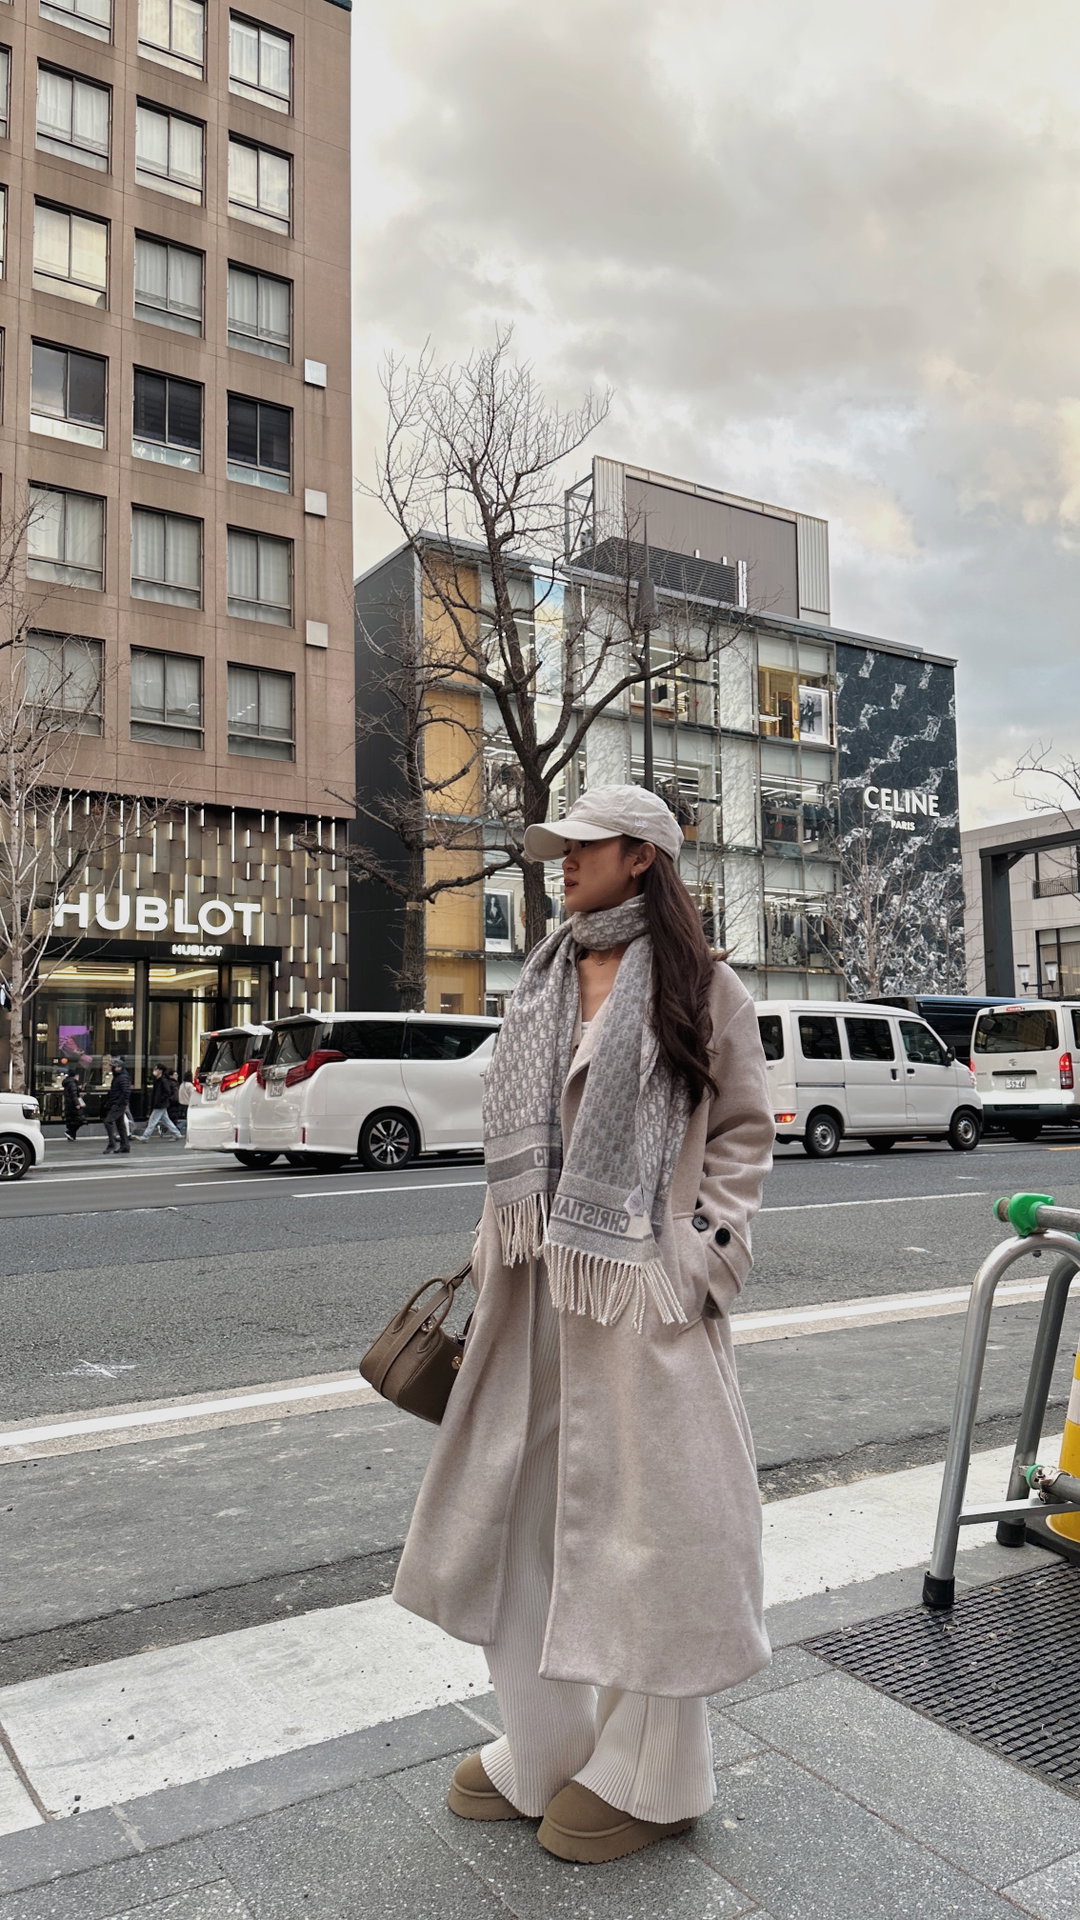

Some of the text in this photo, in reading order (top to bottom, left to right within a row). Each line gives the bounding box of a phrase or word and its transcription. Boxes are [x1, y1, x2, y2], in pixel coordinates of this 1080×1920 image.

[864, 786, 940, 817] CELINE
[891, 820, 915, 831] PARIS
[54, 892, 261, 936] HUBLOT
[172, 944, 223, 956] HUBLOT
